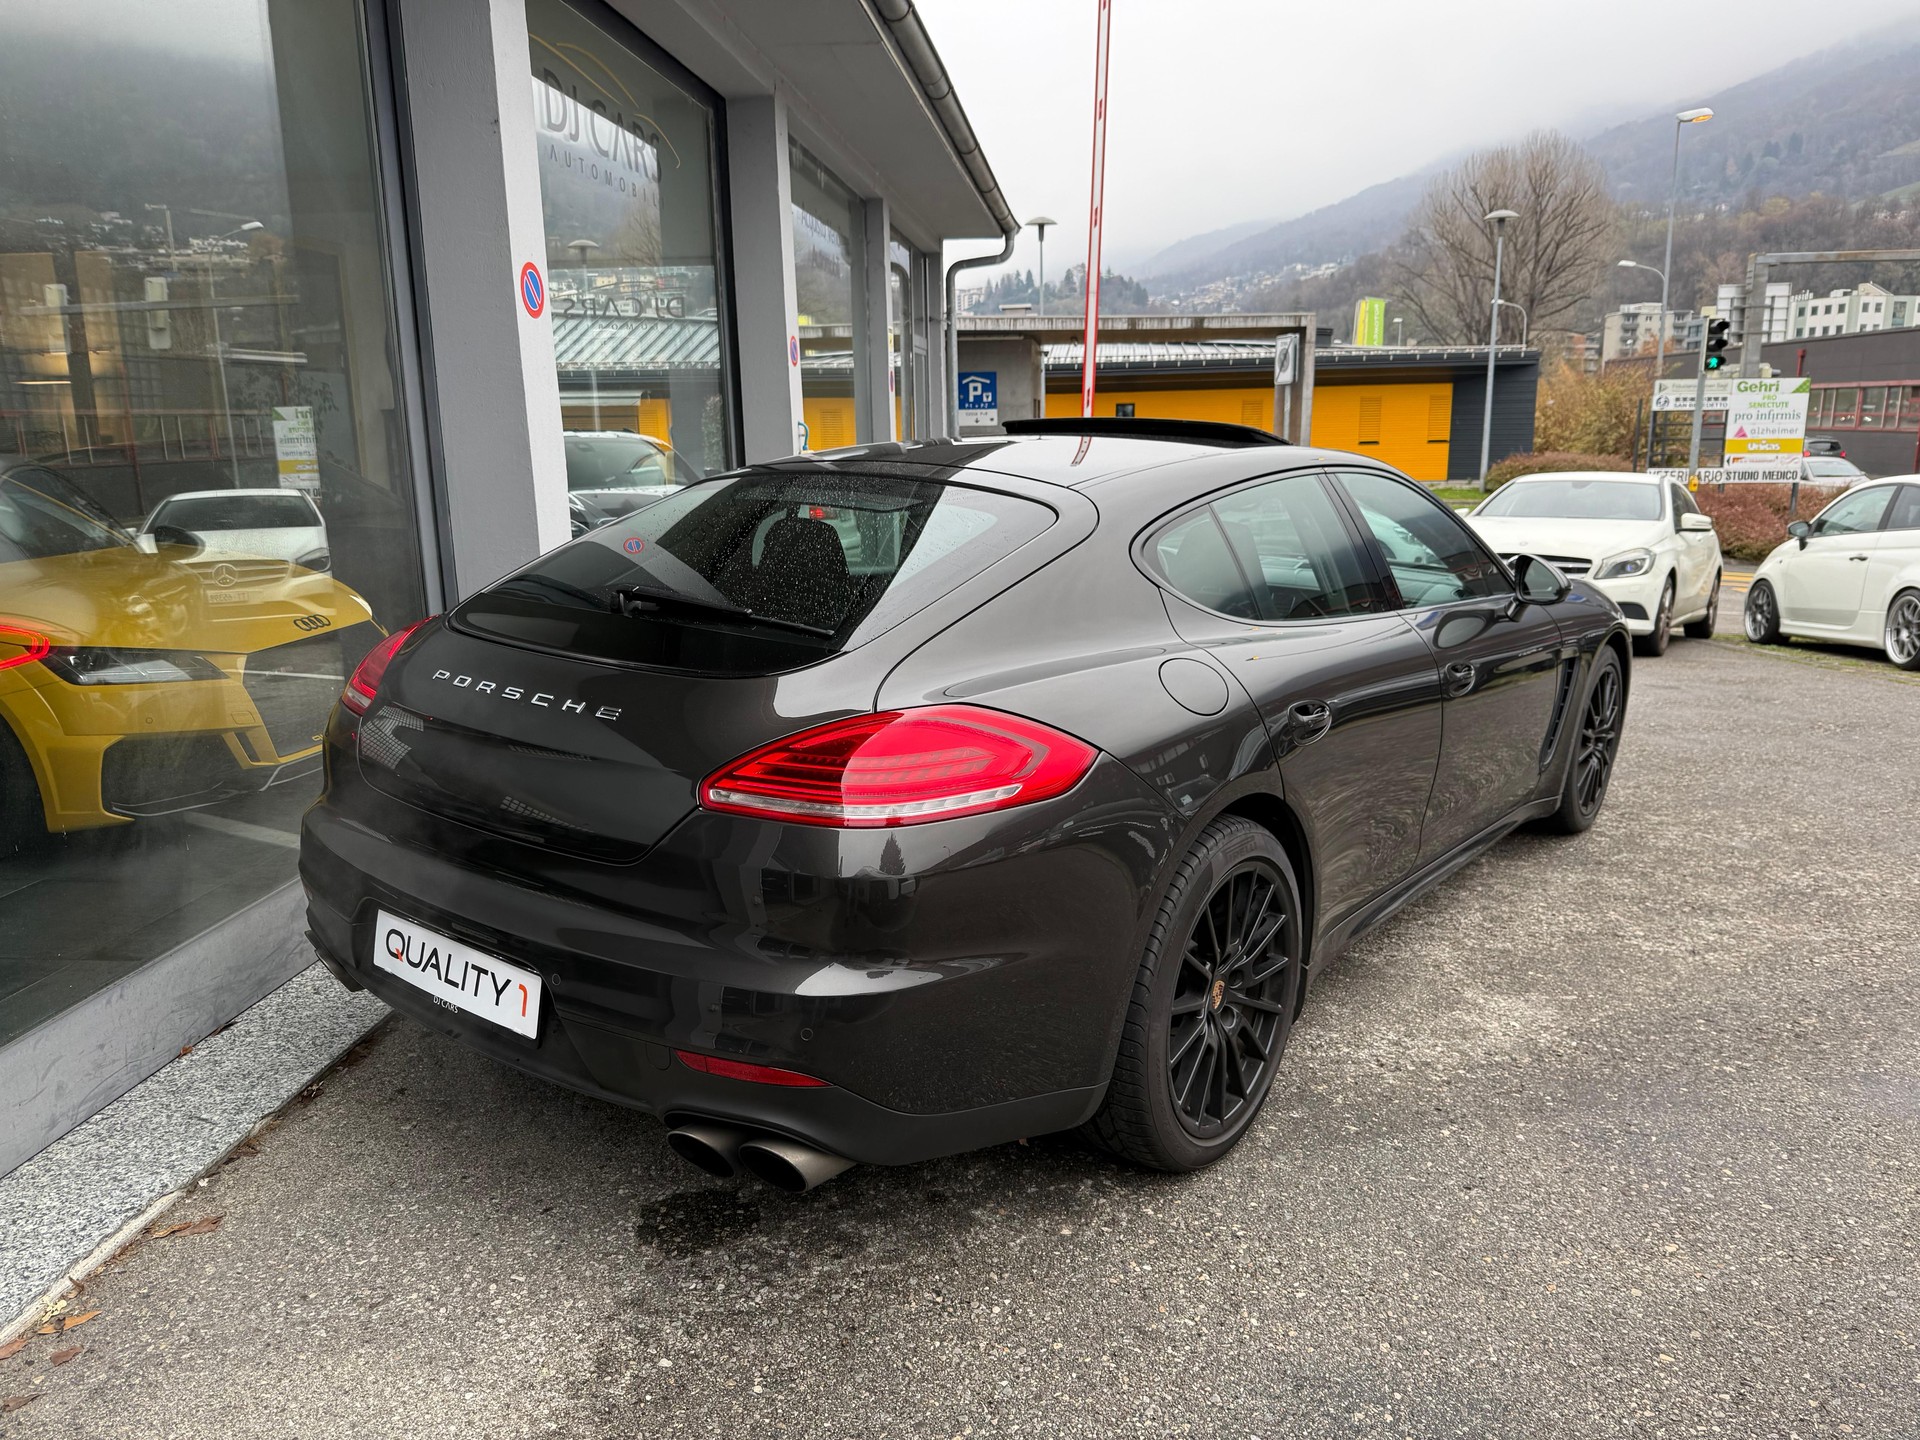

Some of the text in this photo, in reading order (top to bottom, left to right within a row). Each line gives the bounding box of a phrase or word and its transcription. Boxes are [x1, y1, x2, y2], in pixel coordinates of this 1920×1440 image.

[544, 67, 662, 184] DJ CARS
[1736, 380, 1780, 393] Gehri
[1748, 401, 1789, 409] SENECTUTE
[1734, 409, 1801, 423] pro infirmis
[1750, 426, 1799, 435] alzheimer
[1725, 470, 1759, 481] STUDIO
[1762, 469, 1798, 481] MEDICO
[432, 669, 622, 721] PORSCHE
[441, 1000, 458, 1014] CARS
